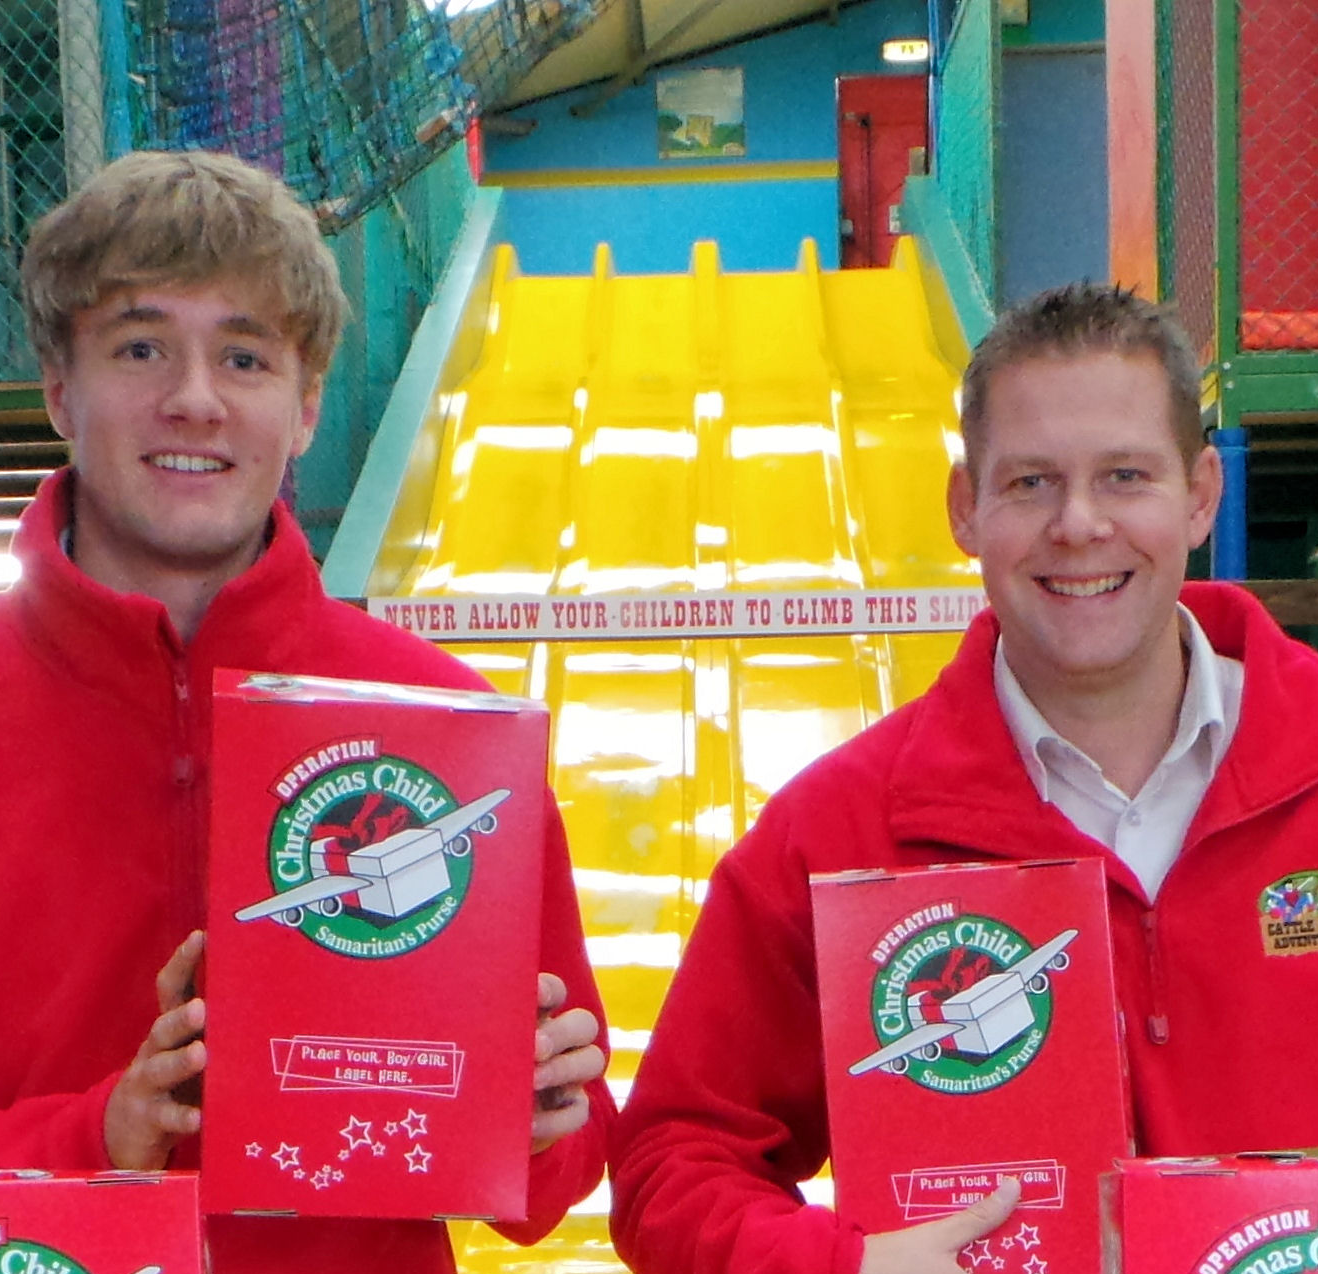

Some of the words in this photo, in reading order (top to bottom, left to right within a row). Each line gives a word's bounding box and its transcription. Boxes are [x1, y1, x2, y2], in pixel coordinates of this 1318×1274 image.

[384, 603, 457, 630] NEVER
[468, 602, 540, 630] ALLOW
[552, 601, 607, 629] YOUR
[620, 600, 733, 628] CHILDREN
[747, 599, 771, 625] TO
[783, 597, 853, 625] CLIMB
[866, 596, 917, 624] THIS
[930, 595, 986, 623] SLID
[276, 739, 376, 799] OPERATION
[276, 768, 366, 883] Christmas
[372, 764, 448, 819] Child
[316, 924, 416, 956] Samaritan's
[415, 895, 457, 940] Purse
[872, 903, 954, 963] OPERATION
[1268, 921, 1315, 936] CATTLE
[880, 928, 950, 1036] Christmas
[955, 922, 1022, 963] Child
[921, 1066, 1011, 1093] Samaritan's
[1009, 1029, 1042, 1072] Purse
